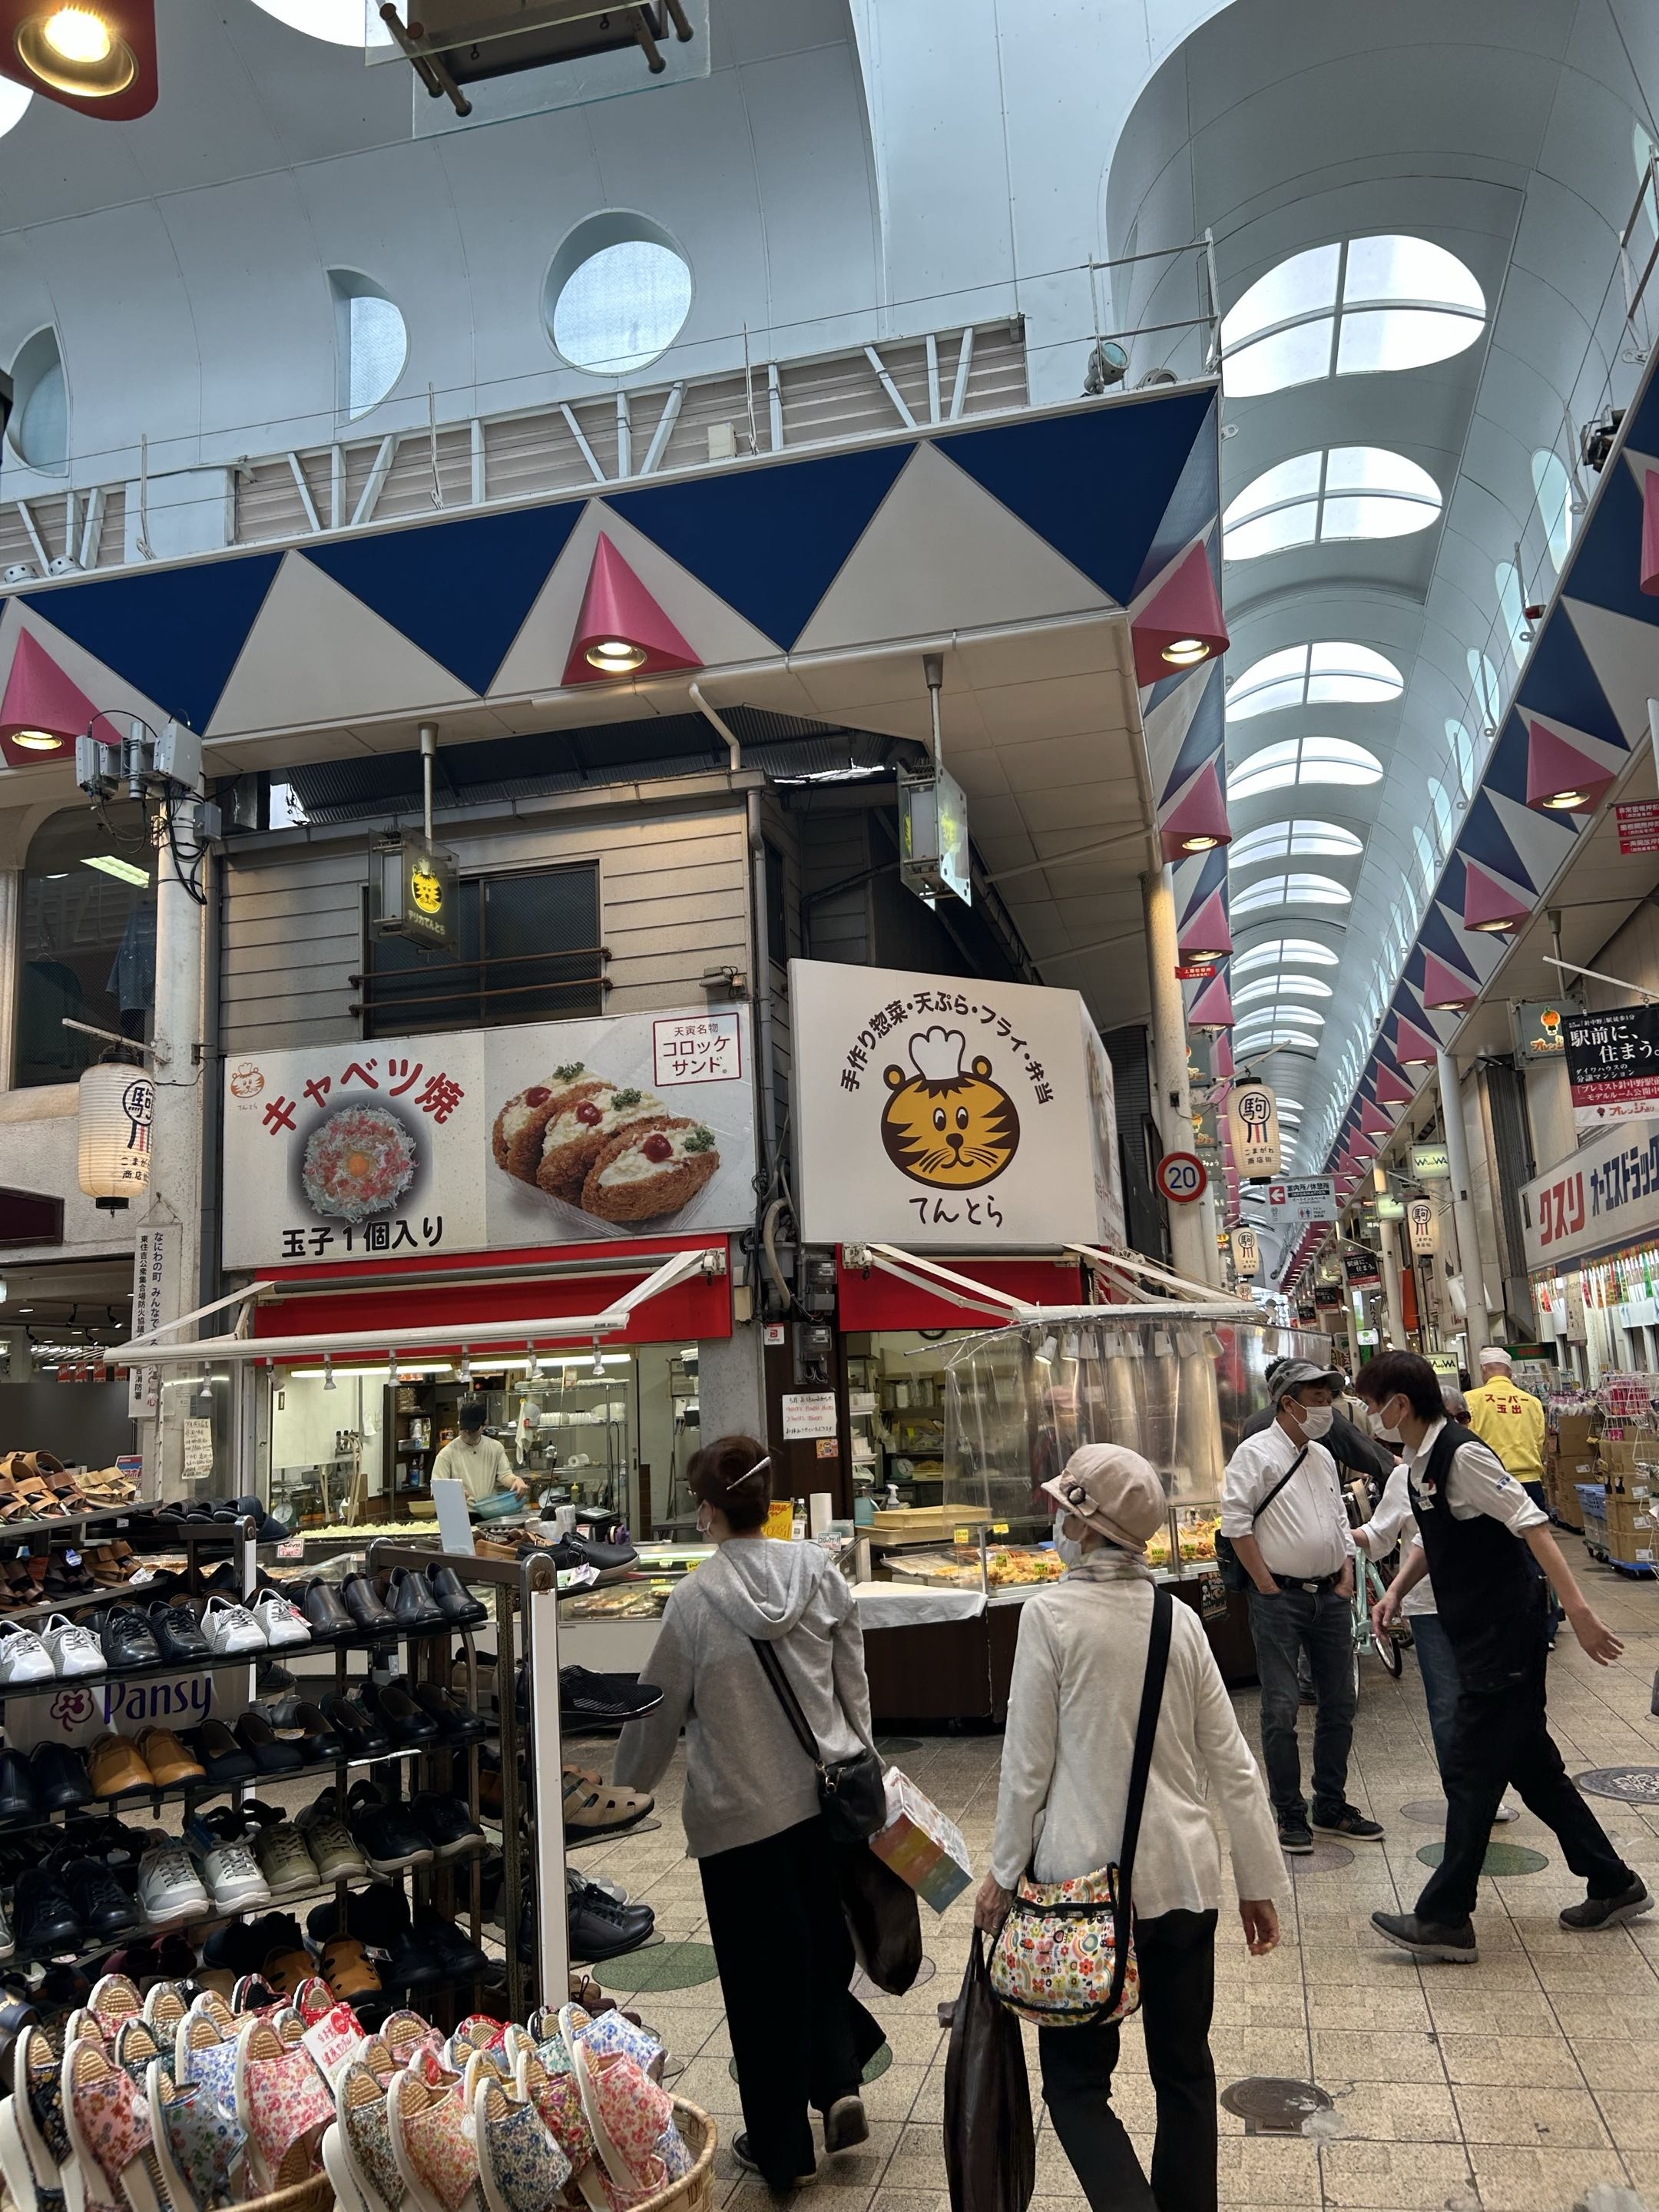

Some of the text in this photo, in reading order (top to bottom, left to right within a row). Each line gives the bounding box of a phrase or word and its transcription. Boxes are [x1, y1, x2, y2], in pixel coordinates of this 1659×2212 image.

[674, 1022, 719, 1037] 天寅名物
[1570, 1026, 1638, 1048] 駅前に、
[663, 1035, 730, 1057] コロッケ
[840, 991, 1054, 1104] 手作り惣菜・天ぷら・フライ・弁当
[1598, 1040, 1659, 1064] 住まう。
[672, 1056, 723, 1077] サンド
[262, 1058, 465, 1136] キャベツ焼
[1243, 1098, 1267, 1121] 駒
[1244, 1147, 1274, 1156] こまがわ
[1168, 1166, 1197, 1189] 20
[909, 1194, 1003, 1227] てんとら
[1539, 1171, 1585, 1247] クスリ
[282, 1216, 442, 1258] 玉子1個入り
[151, 1231, 164, 1283] なにわの町
[1485, 1394, 1529, 1404] スーパー
[1496, 1404, 1522, 1414] 玉出
[104, 1677, 212, 1724] Pansy
